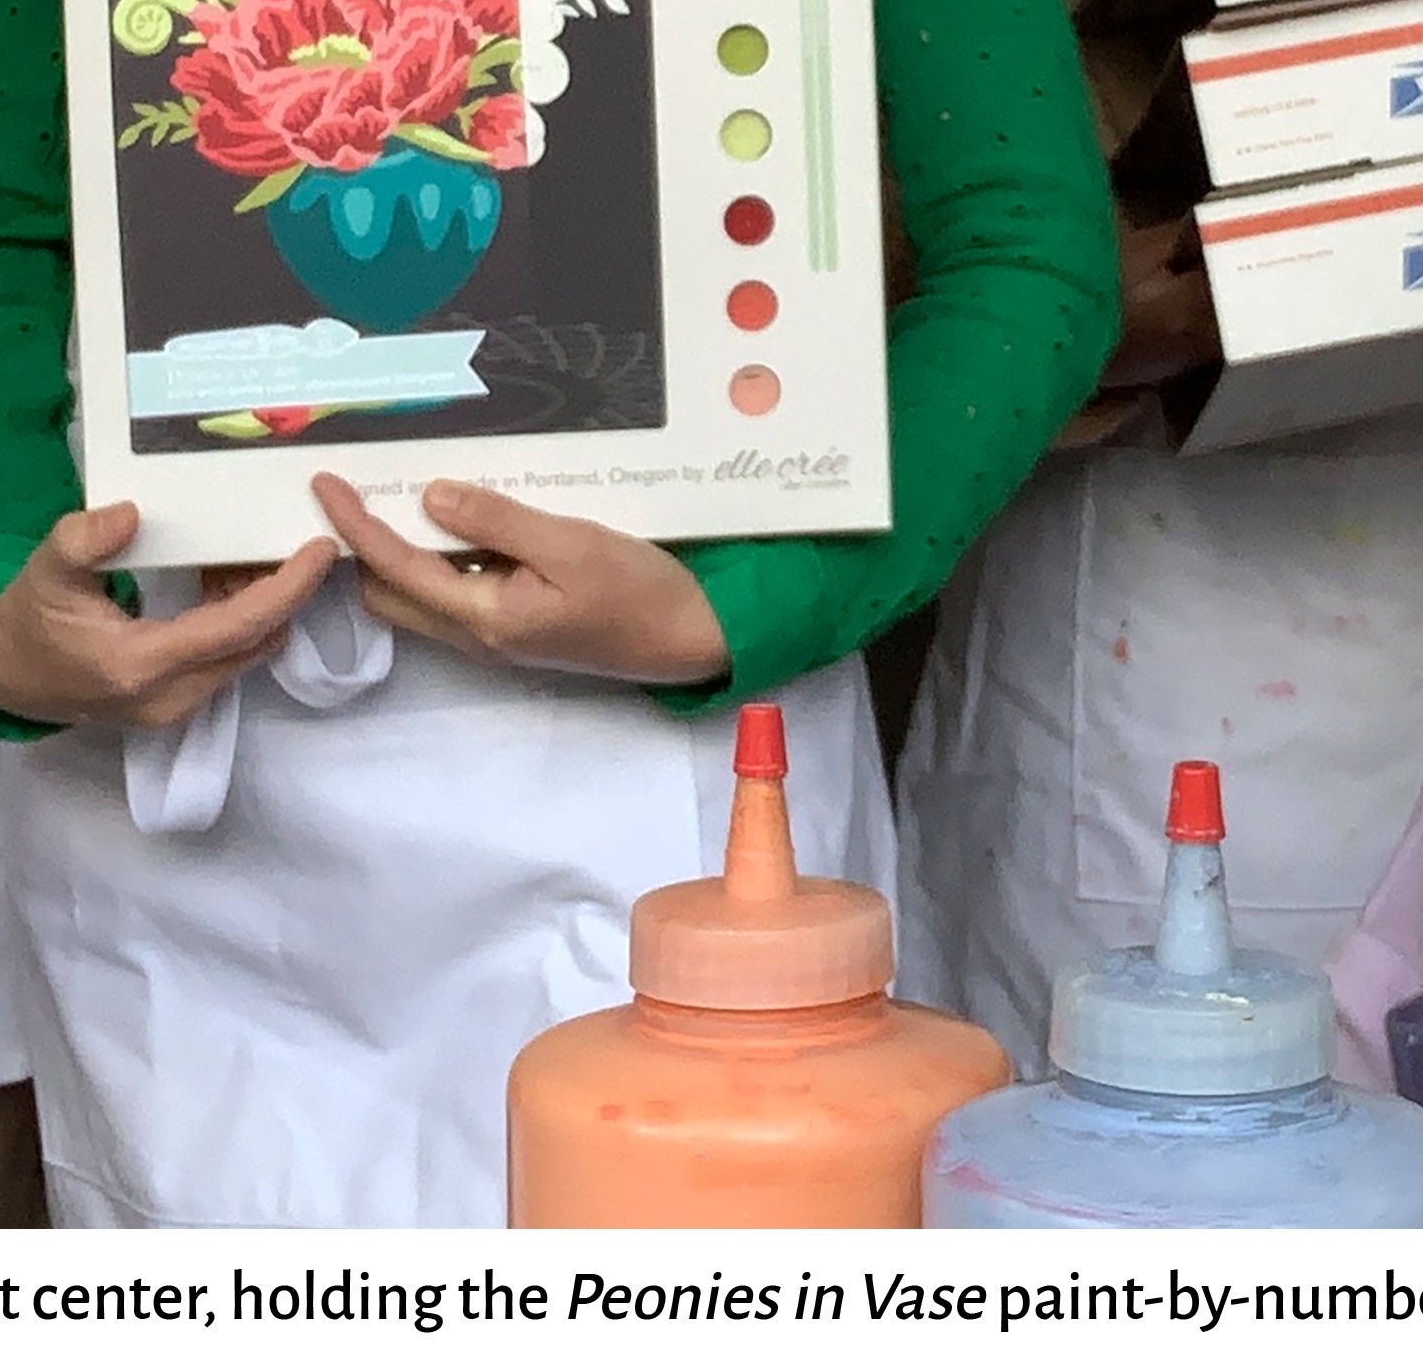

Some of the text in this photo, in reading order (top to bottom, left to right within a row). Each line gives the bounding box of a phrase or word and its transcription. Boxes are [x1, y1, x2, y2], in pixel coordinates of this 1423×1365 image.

[608, 466, 678, 486] Oregon
[682, 464, 706, 483] by
[713, 448, 774, 480] elle
